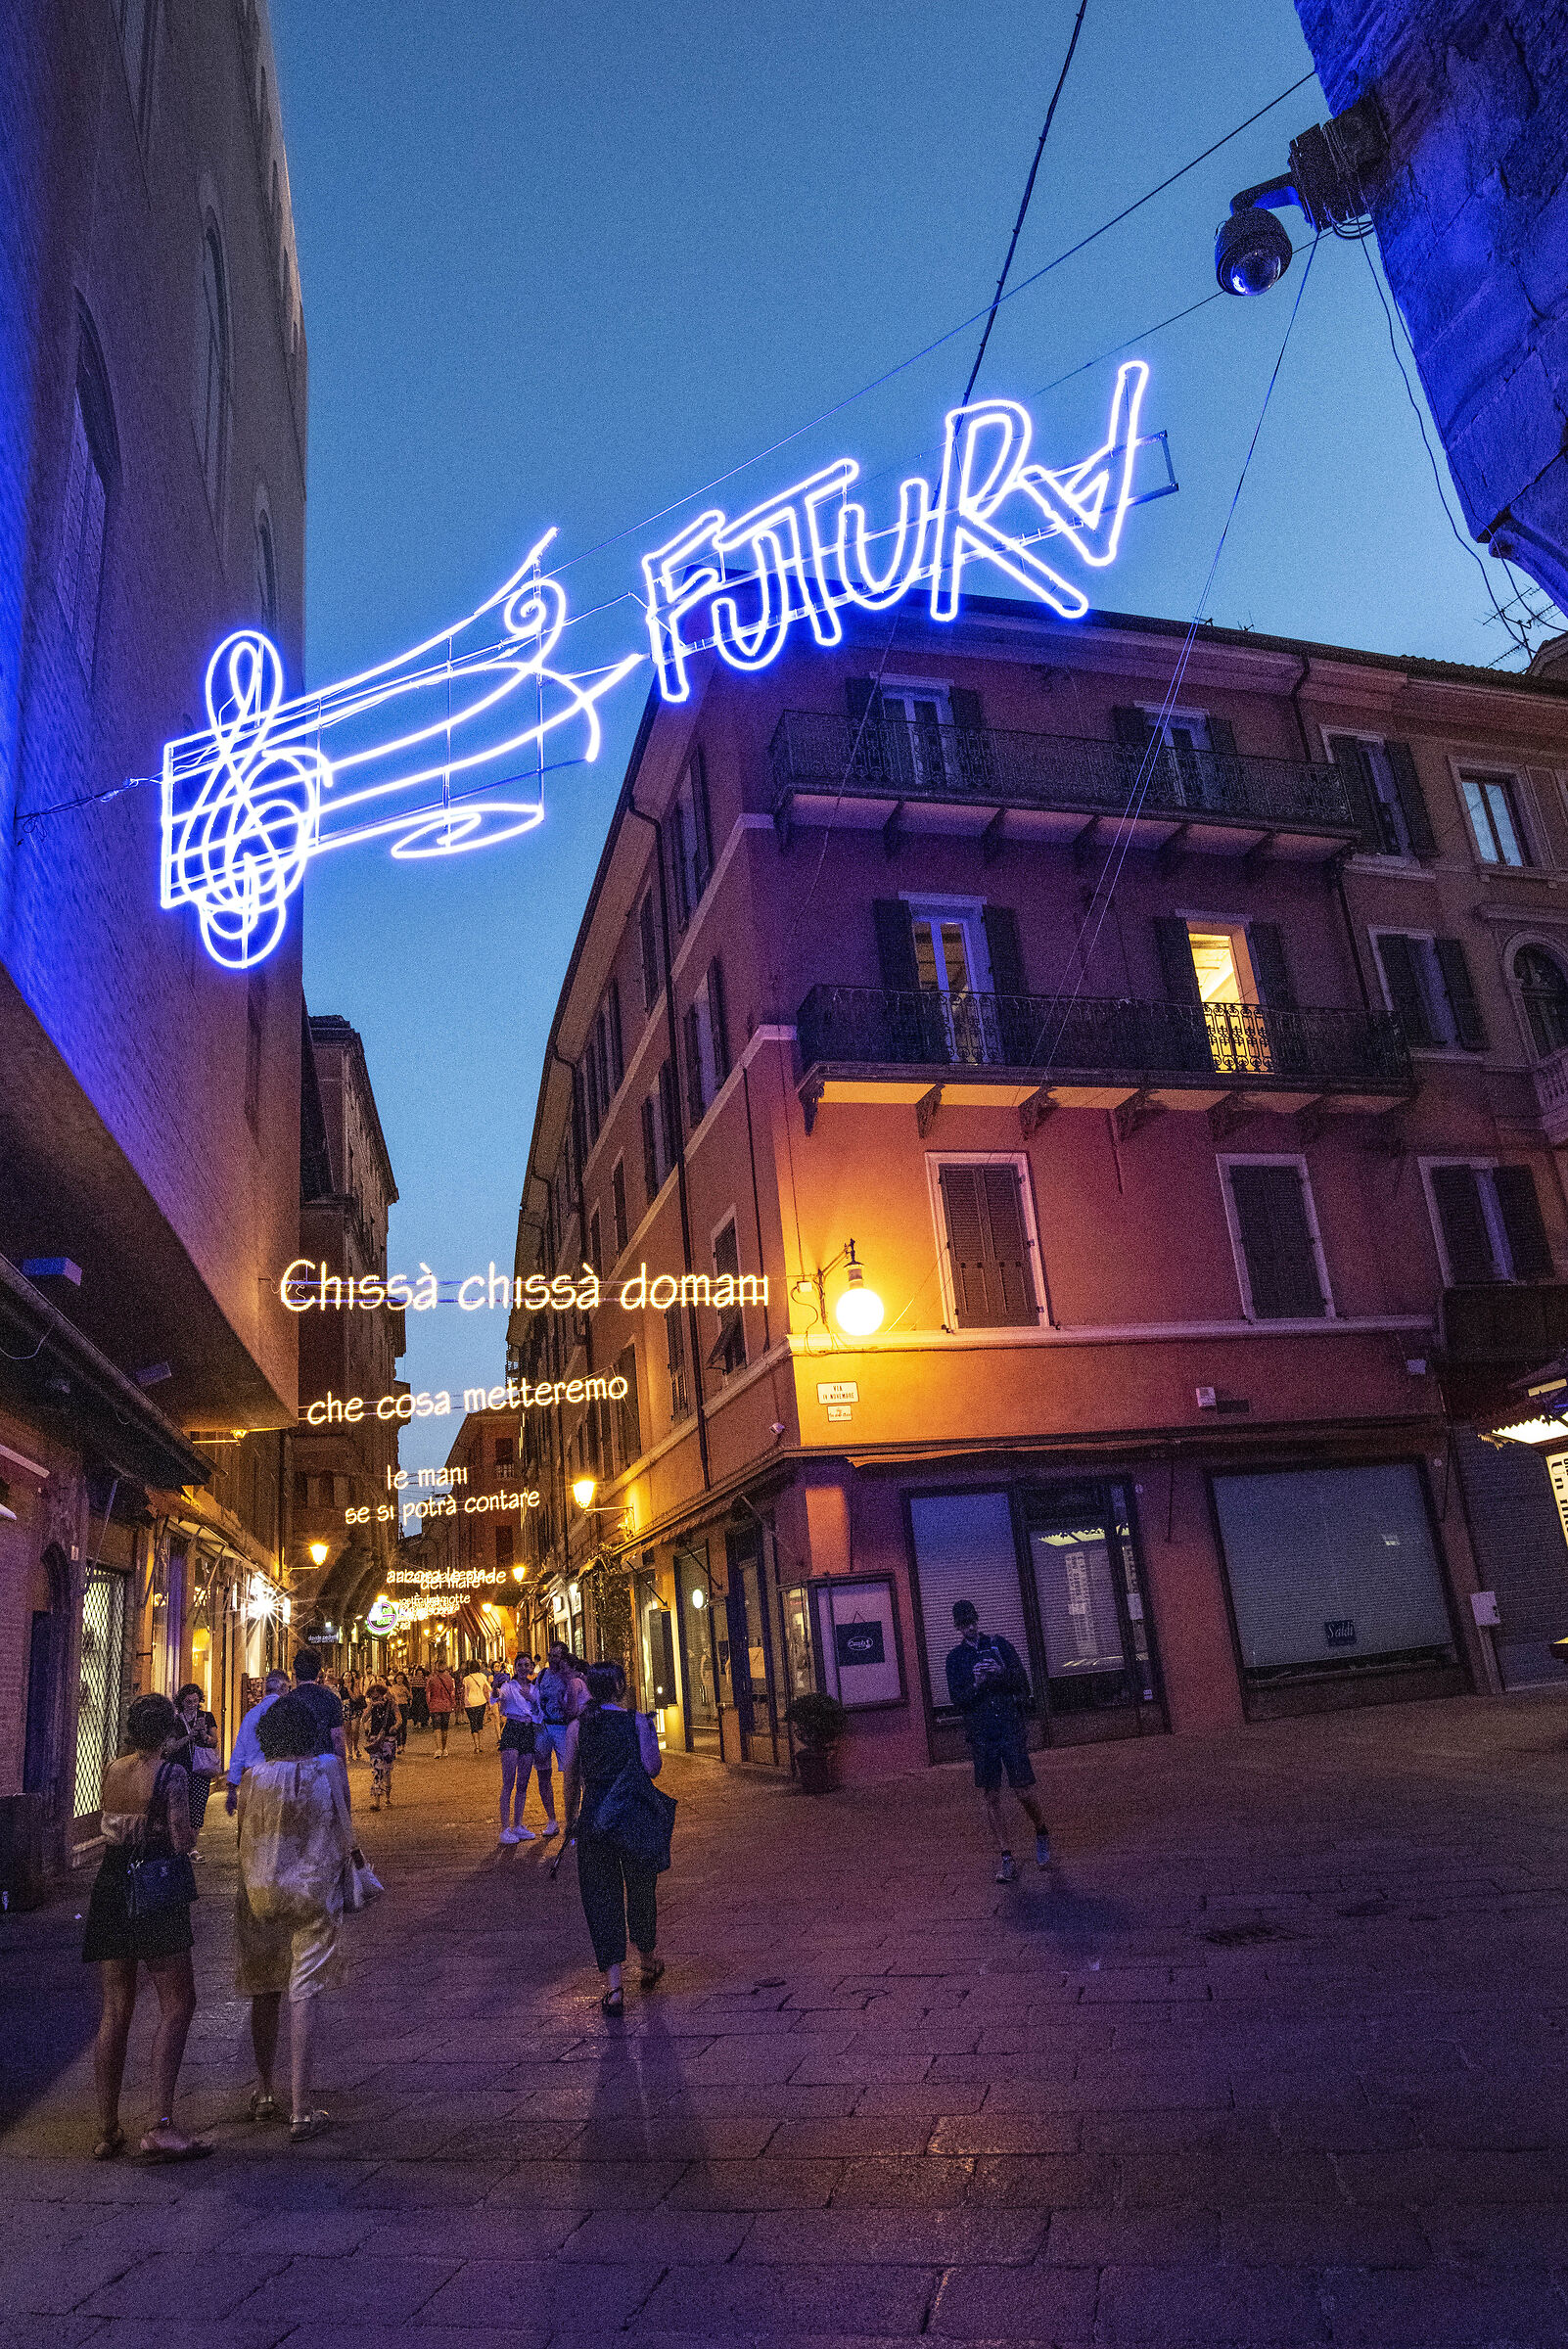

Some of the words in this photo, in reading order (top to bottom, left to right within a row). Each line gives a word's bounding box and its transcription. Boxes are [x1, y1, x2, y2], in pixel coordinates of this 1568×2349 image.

[280, 1259, 438, 1312] Chissà
[458, 1261, 600, 1310] chissà
[306, 1390, 364, 1425] che
[376, 1390, 451, 1420] cosa
[463, 1375, 628, 1412] metteremo
[387, 1464, 409, 1490] le
[417, 1466, 468, 1488] mani
[345, 1506, 370, 1524] se
[377, 1504, 394, 1522] si
[402, 1495, 457, 1526] potrà
[464, 1489, 540, 1514] contare
